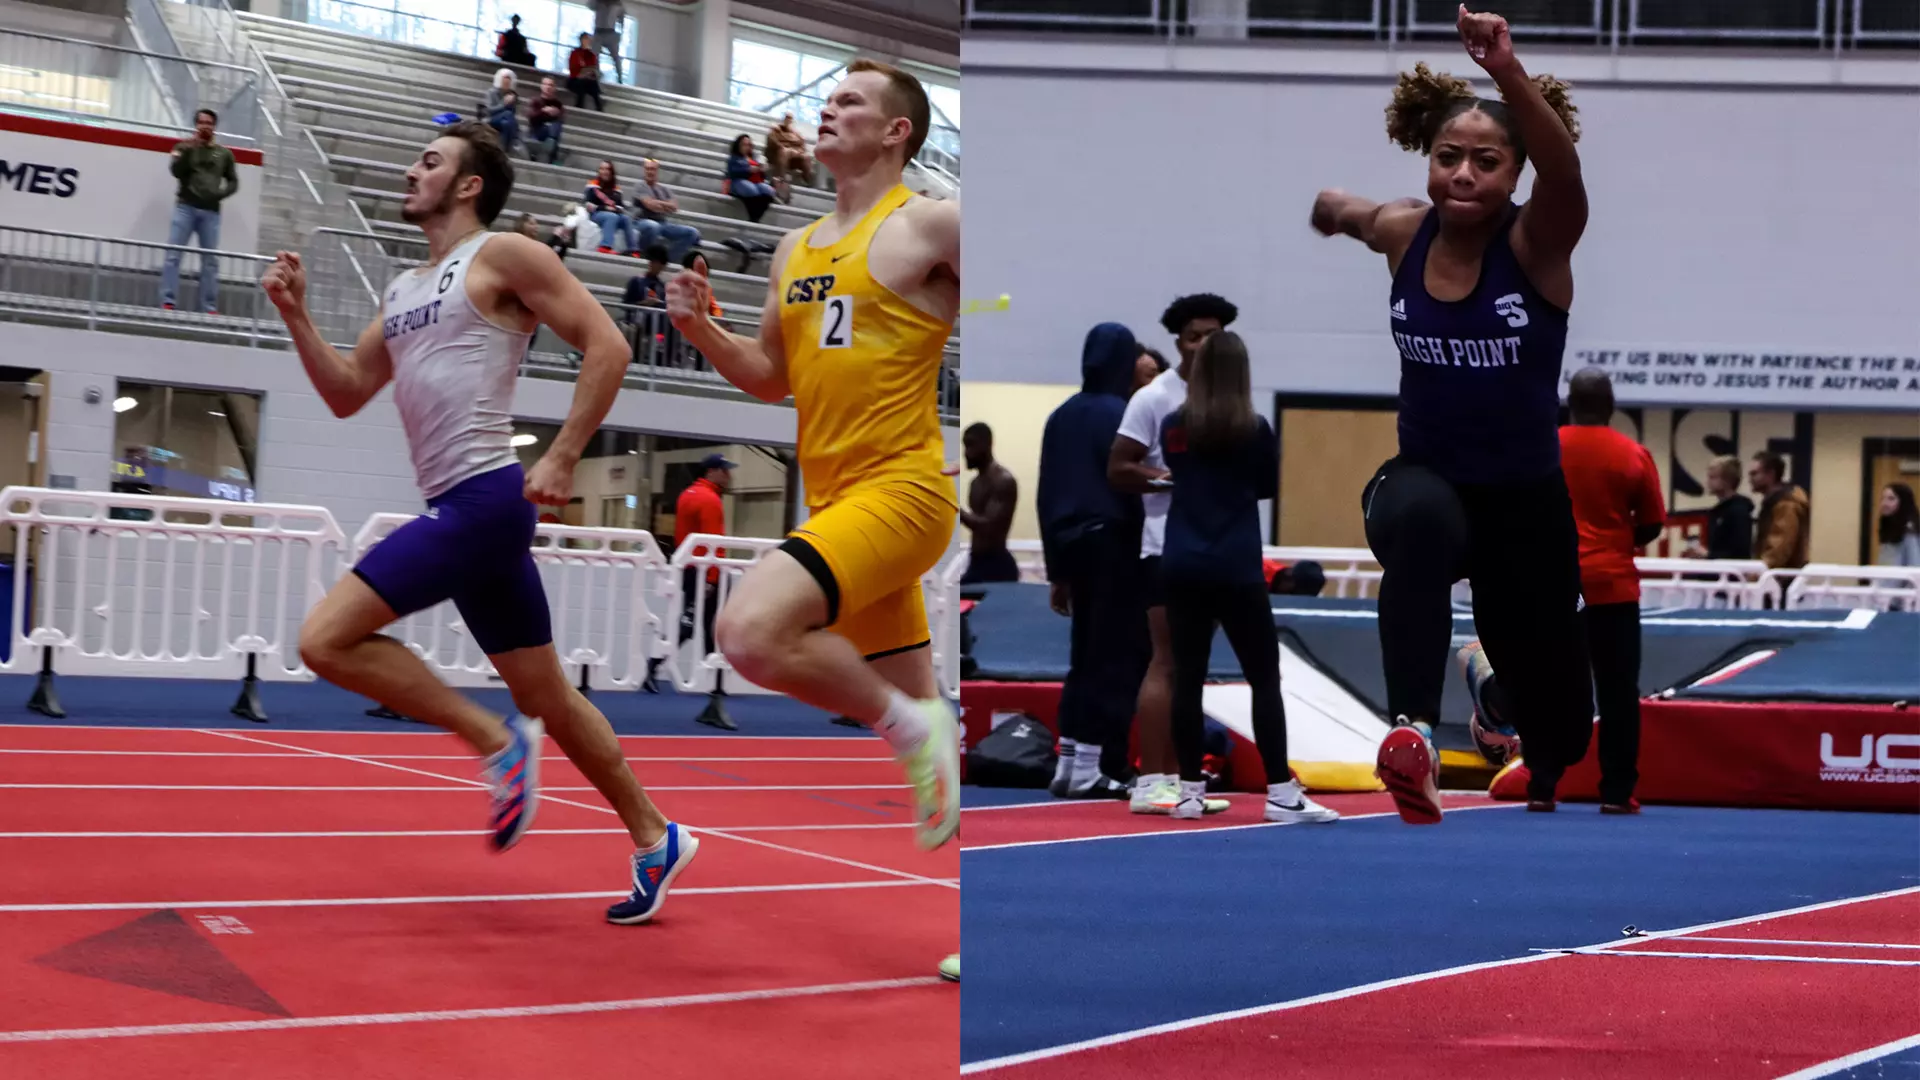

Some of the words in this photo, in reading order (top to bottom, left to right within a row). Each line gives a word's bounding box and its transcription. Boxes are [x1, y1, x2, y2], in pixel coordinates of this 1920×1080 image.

[0, 159, 80, 198] MES
[438, 260, 460, 294] 6
[787, 274, 834, 304] CSP
[401, 300, 442, 334] POINT
[826, 299, 844, 346] 2
[1395, 331, 1448, 366] HIGH
[1448, 336, 1521, 367] POINT
[1627, 352, 1650, 366] US
[1656, 353, 1697, 367] RUN
[1704, 354, 1755, 368] WITH
[1760, 355, 1853, 371] PATIENCE
[1860, 357, 1897, 372] THE
[1654, 373, 1707, 387] UNTO
[1713, 374, 1770, 389] JESUS
[1777, 375, 1815, 390] THE
[1821, 376, 1900, 391] AUTHOR
